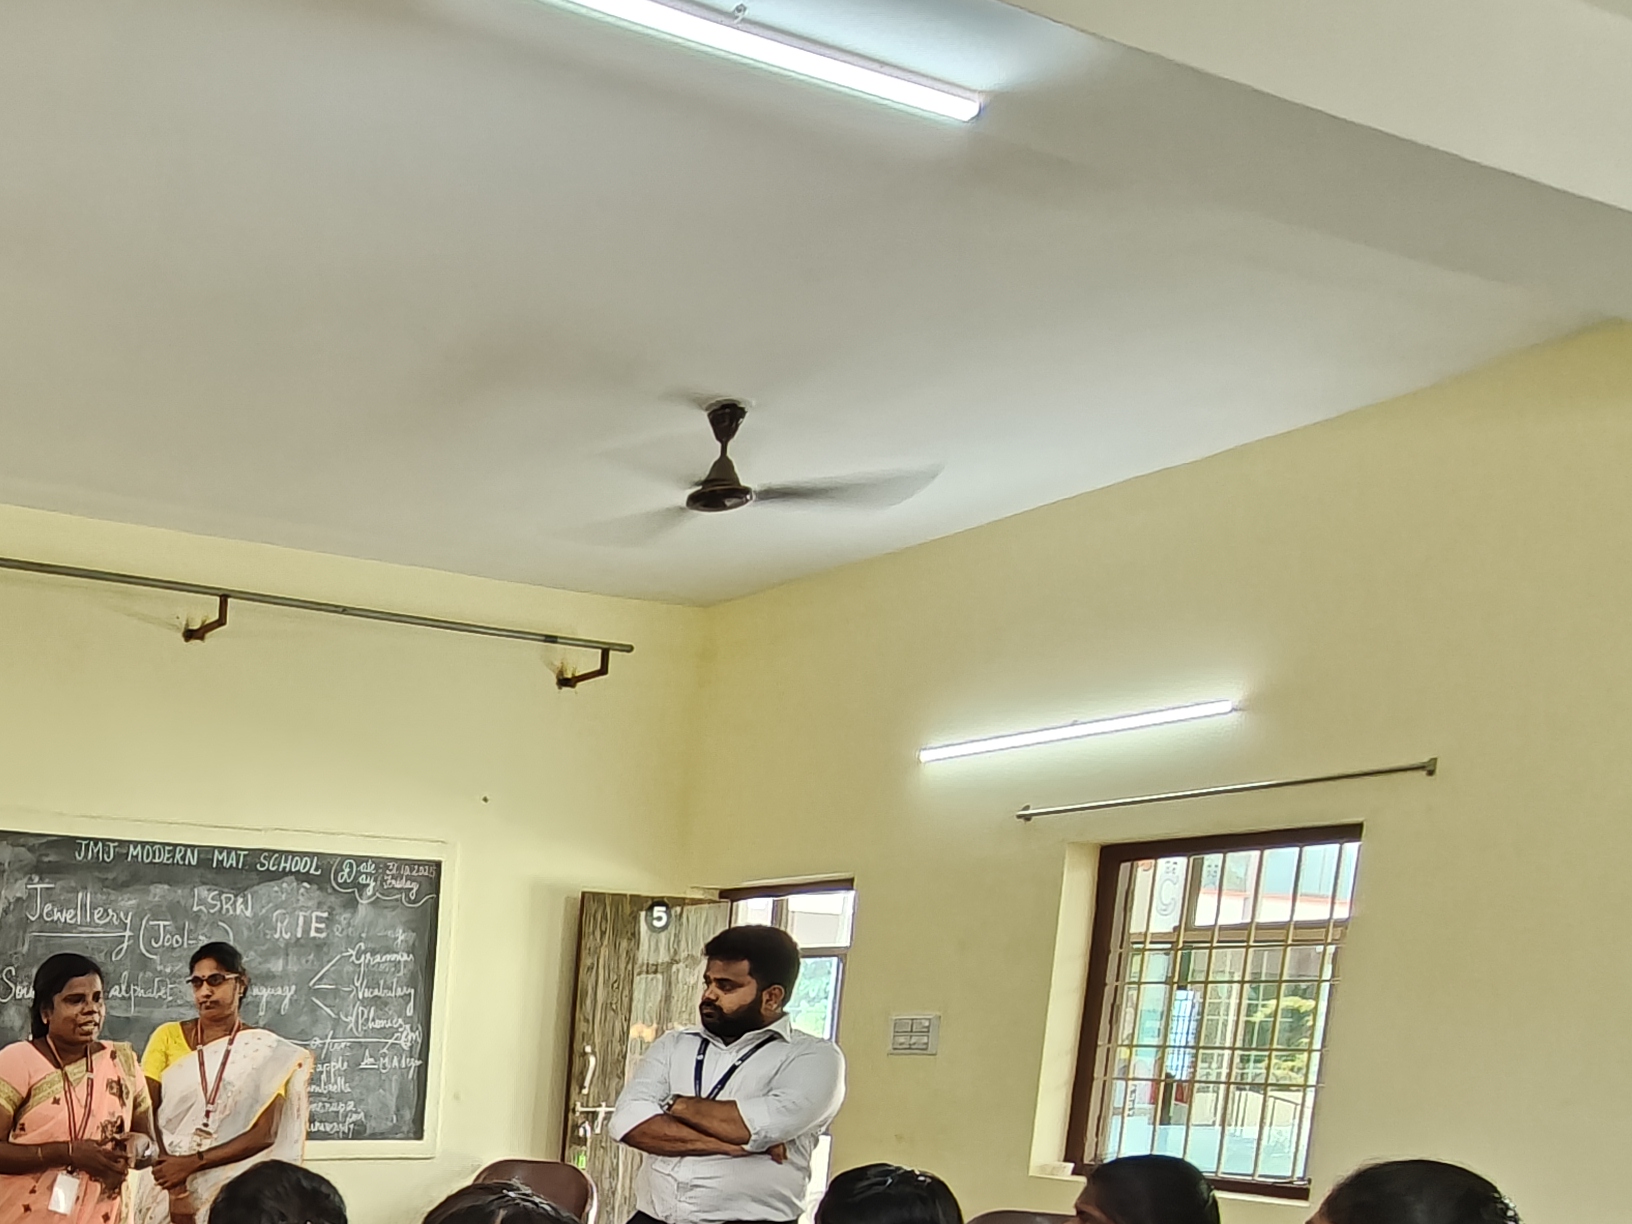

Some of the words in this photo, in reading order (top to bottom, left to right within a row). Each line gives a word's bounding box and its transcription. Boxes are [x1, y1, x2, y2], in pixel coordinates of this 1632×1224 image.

[74, 840, 117, 862] JMJ
[127, 844, 198, 866] MODERN
[256, 853, 321, 876] SCHOOL
[25, 884, 134, 961] Jewellery
[272, 909, 328, 939] RTE
[652, 906, 667, 928] 5
